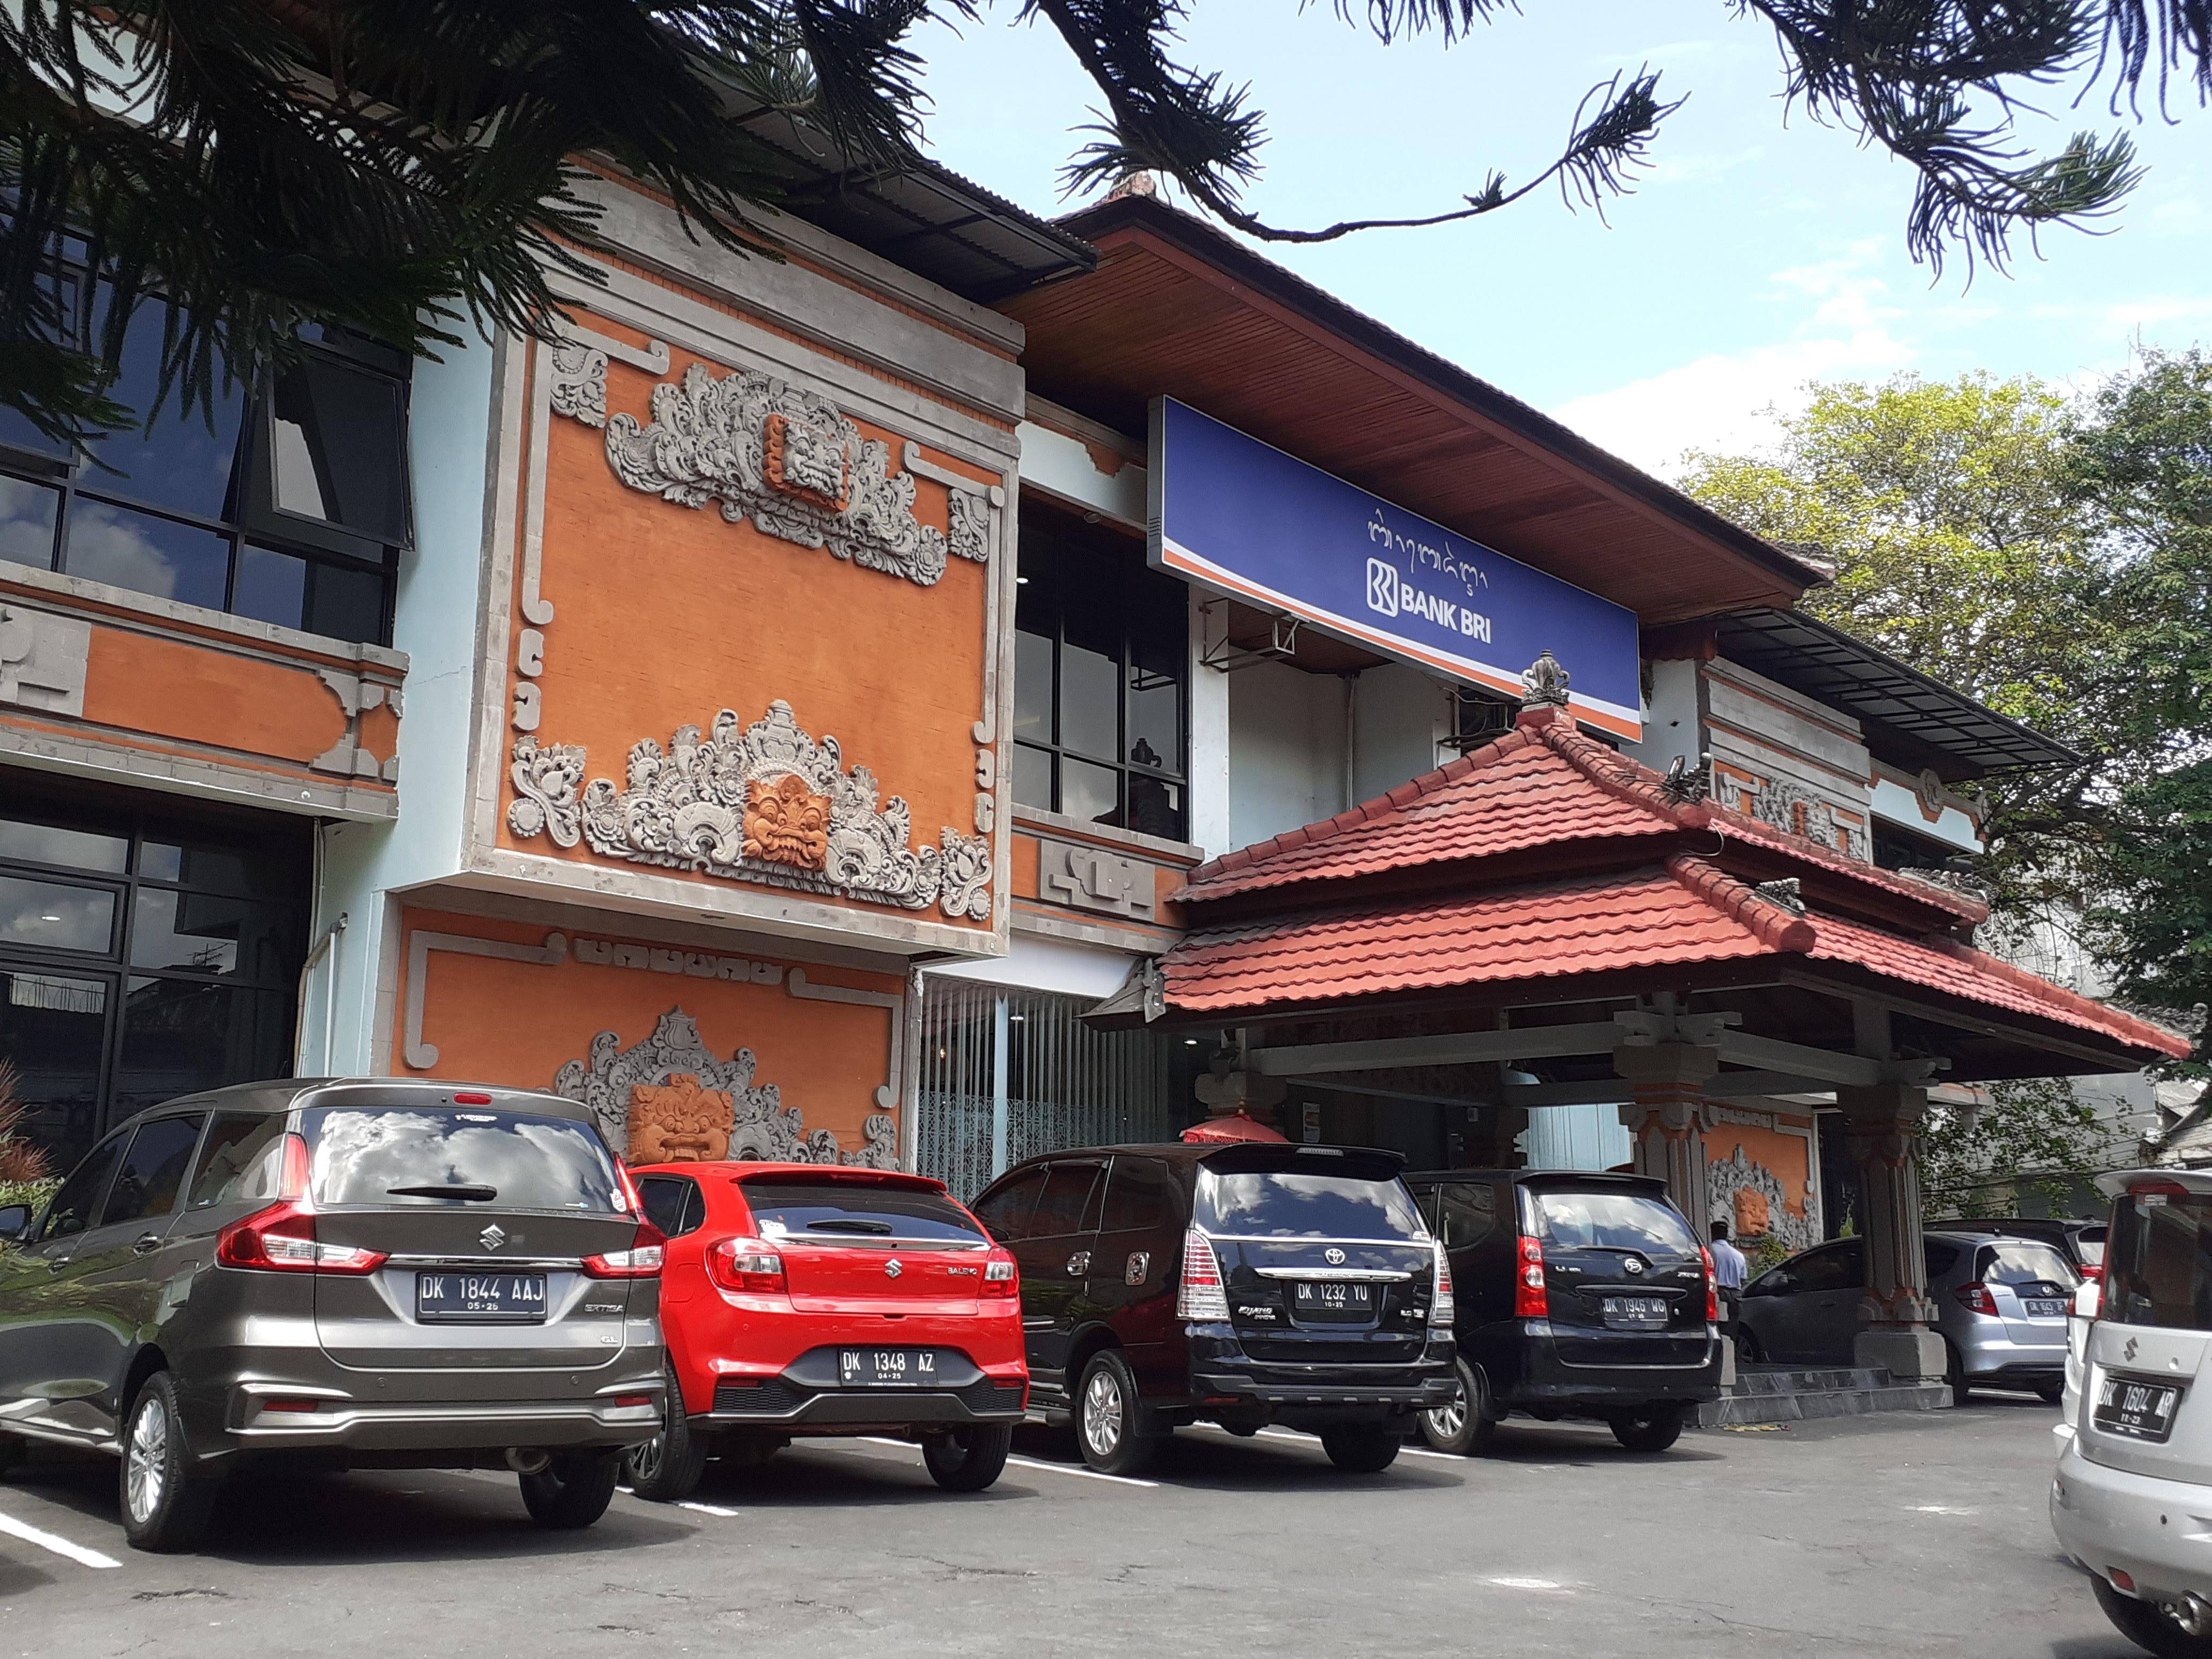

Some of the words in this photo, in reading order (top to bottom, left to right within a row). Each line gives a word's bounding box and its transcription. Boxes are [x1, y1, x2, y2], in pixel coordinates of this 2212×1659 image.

[1401, 583, 1458, 631] BANK
[1461, 608, 1491, 644] BRI
[423, 1276, 444, 1298] DK
[459, 1277, 500, 1299] 1844
[512, 1278, 543, 1301] AAJ
[1298, 1283, 1312, 1299] DK
[1320, 1284, 1346, 1301] 1232
[1353, 1284, 1367, 1301] YU
[1604, 1298, 1618, 1312] DK
[1624, 1299, 1646, 1312] 1946
[843, 1352, 861, 1370] DK
[874, 1352, 906, 1371] 1348
[918, 1354, 934, 1371] AZ
[2098, 1381, 2118, 1407] DK
[2123, 1386, 2154, 1413] 1604
[2155, 1391, 2173, 1418] AR
